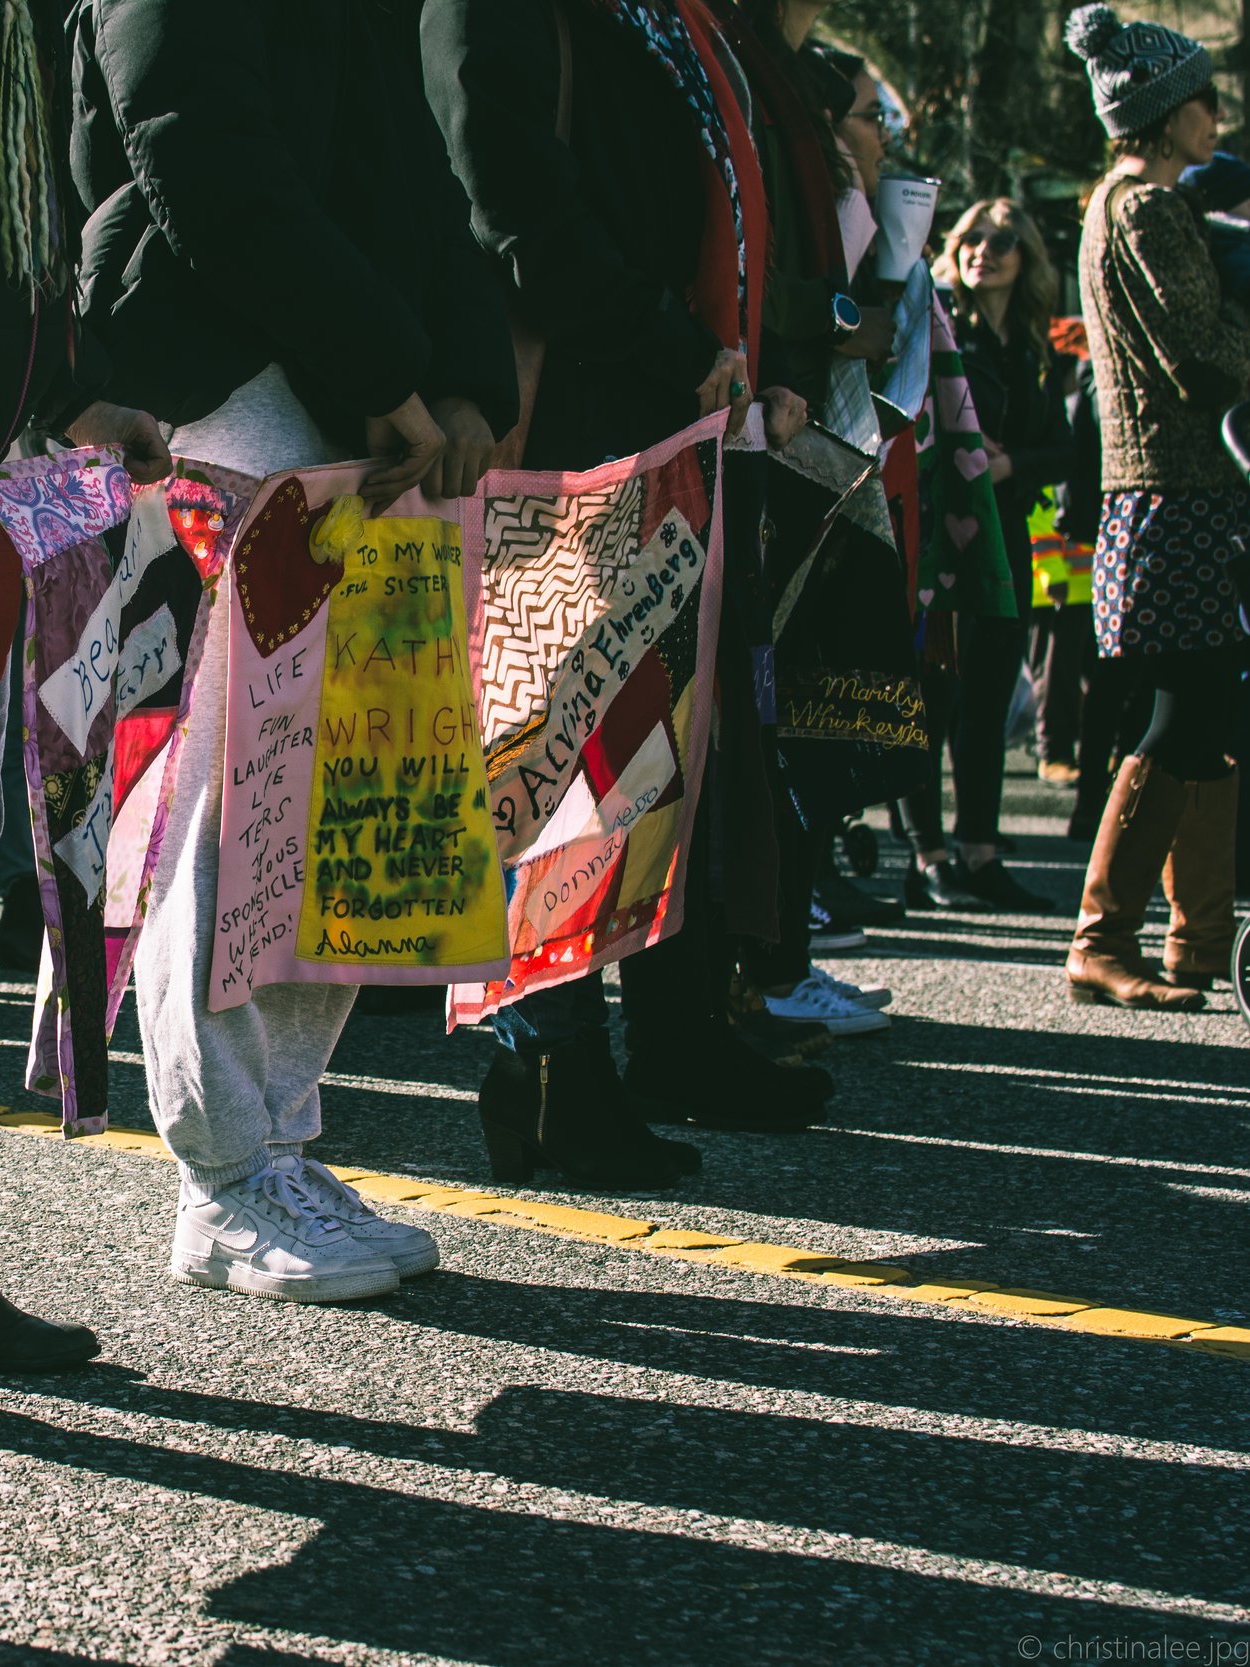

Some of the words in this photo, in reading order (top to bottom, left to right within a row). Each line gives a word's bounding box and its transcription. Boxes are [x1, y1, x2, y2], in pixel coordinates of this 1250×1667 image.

[357, 544, 378, 567] TO
[395, 542, 424, 564] MY
[384, 574, 448, 597] SISTER
[248, 647, 307, 709] LIFE
[819, 675, 927, 718] Marilyn
[258, 713, 296, 743] FUN
[787, 700, 929, 751] Whiskeyja
[324, 756, 379, 787] YOU
[402, 753, 470, 778] WILL
[319, 797, 410, 826] ALWAYS
[434, 792, 462, 819] BE
[314, 826, 363, 855] MY
[375, 826, 468, 855] HEART
[316, 858, 372, 882] AND
[388, 856, 465, 880] NEVER
[320, 895, 465, 921] FORGOTTEN
